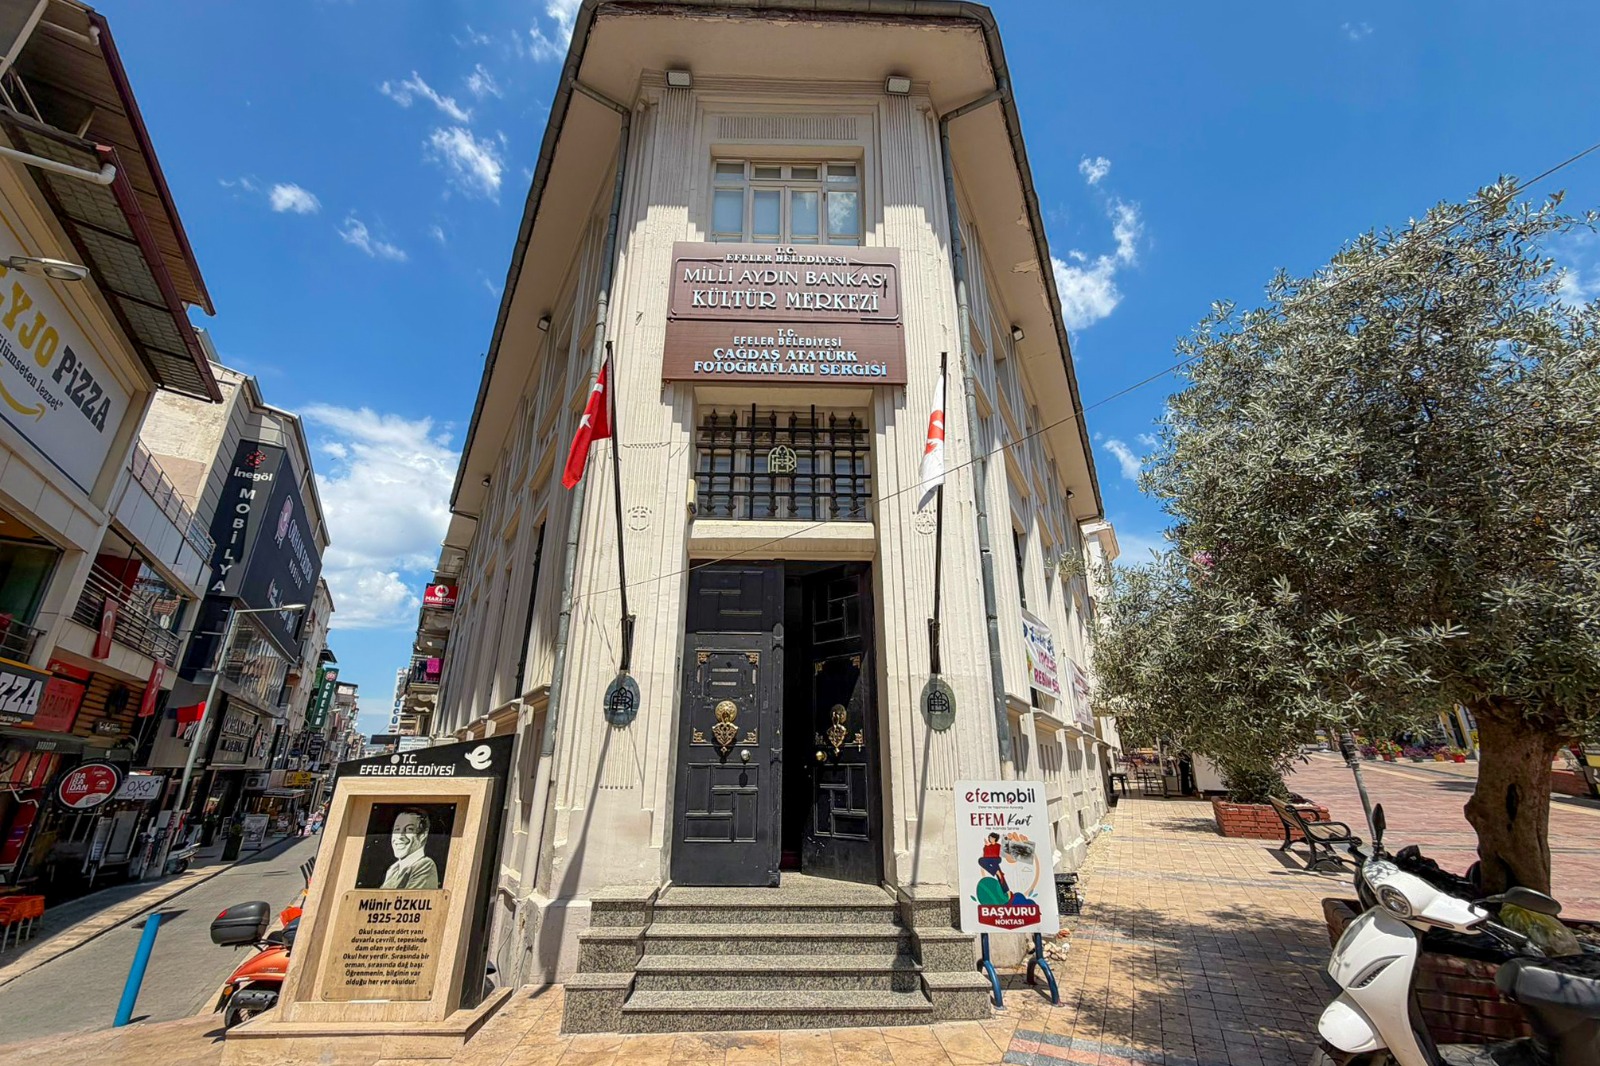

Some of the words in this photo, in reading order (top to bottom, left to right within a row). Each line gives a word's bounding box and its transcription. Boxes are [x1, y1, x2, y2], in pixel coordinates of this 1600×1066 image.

[775, 247, 797, 255] T.C.
[725, 253, 773, 263] EFELER
[775, 253, 847, 265] BELEDİYESİ
[684, 266, 733, 283] MİLLİ
[739, 269, 797, 284] AYDIN
[691, 287, 777, 308] KÜLTÜR
[785, 291, 879, 312] MERKEZİ
[777, 329, 798, 337] T.C.
[733, 336, 774, 347] EFELER
[778, 335, 842, 348] BELEDİYESİ
[713, 346, 780, 362] ÇAĞDAŞ
[785, 347, 858, 362] ATATÜRK
[693, 360, 815, 374] FOTOĞRAFLARI
[820, 361, 887, 376] SERGİSİ
[425, 596, 455, 604] MARATON
[402, 754, 417, 764] T.C.
[359, 765, 397, 775] EFELER
[398, 763, 456, 776] BELEDİYESİ
[965, 788, 1035, 804] efemobil
[970, 812, 1004, 826] EFEM
[1007, 813, 1032, 826] Kart
[359, 898, 392, 910] Münir
[394, 896, 432, 911] ÖZKUL
[367, 913, 421, 923] 1925-2018
[981, 907, 1036, 919] BAŞVURU
